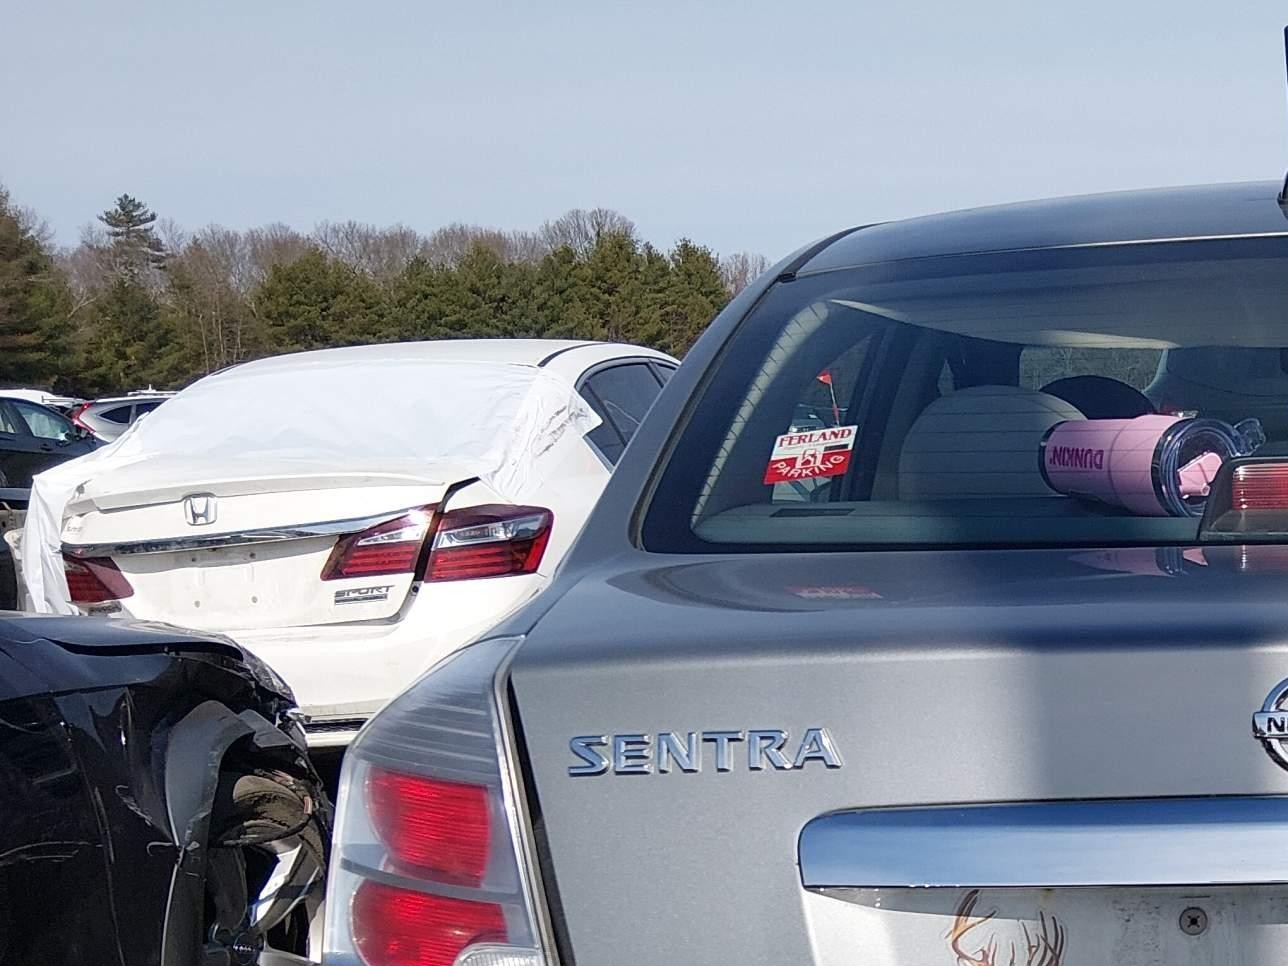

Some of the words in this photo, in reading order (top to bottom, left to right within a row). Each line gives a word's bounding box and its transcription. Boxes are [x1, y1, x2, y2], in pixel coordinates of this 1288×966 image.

[778, 429, 852, 447] FERLAND
[772, 455, 845, 477] PARKING
[335, 585, 395, 597] SPORT
[568, 728, 842, 777] SENTRA
